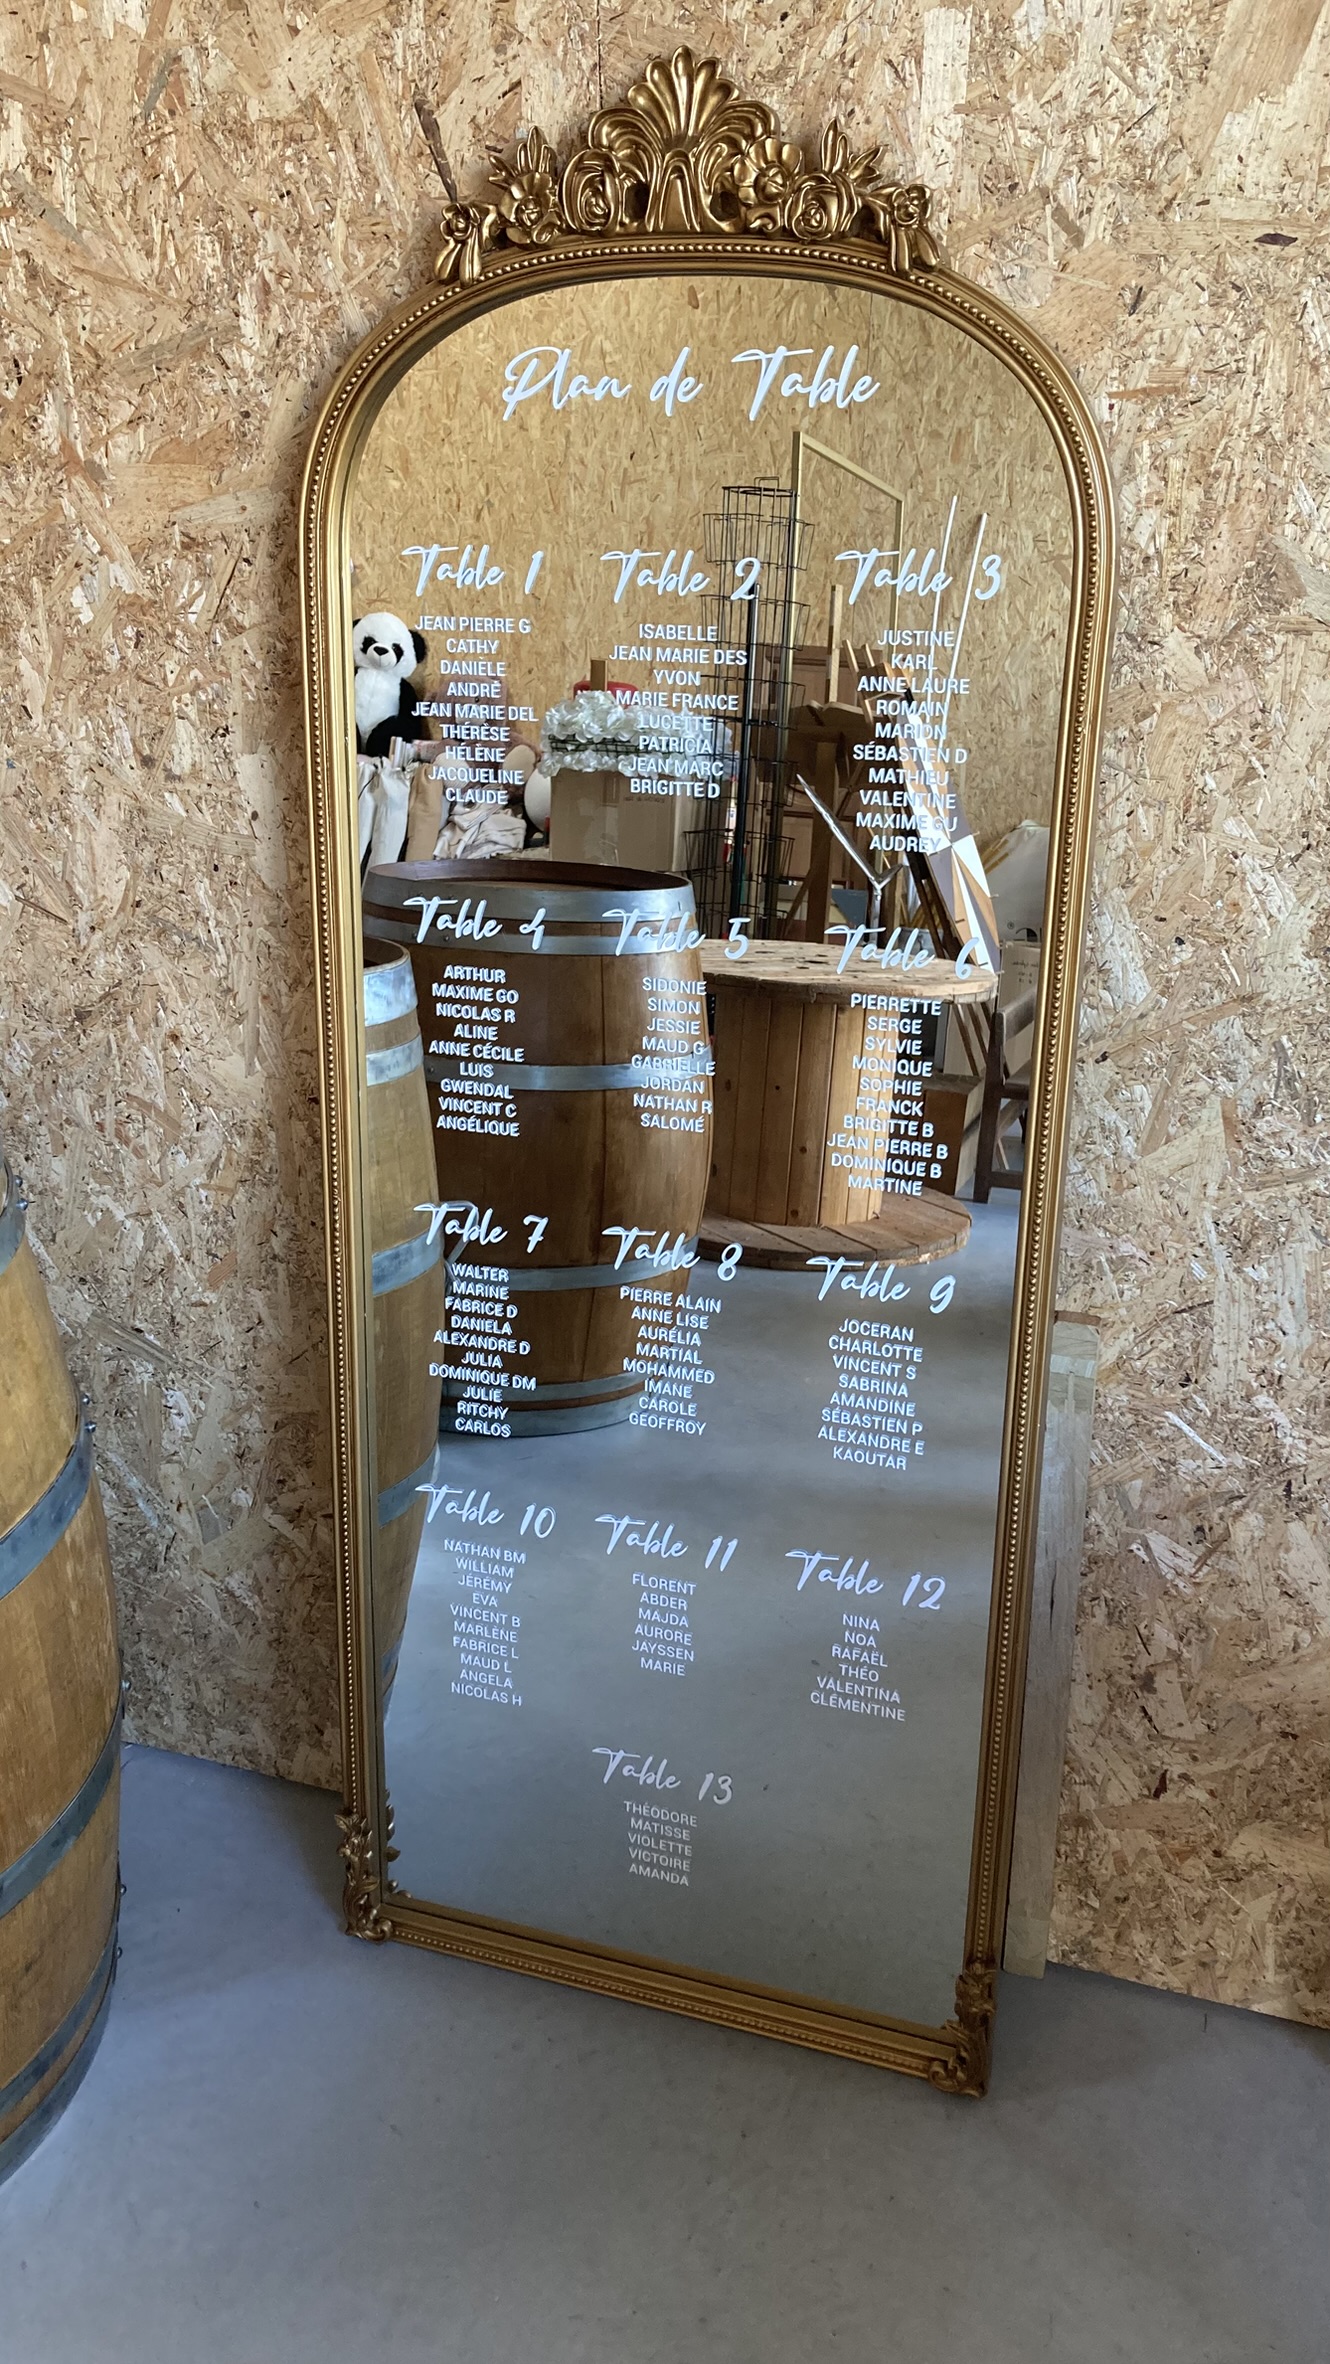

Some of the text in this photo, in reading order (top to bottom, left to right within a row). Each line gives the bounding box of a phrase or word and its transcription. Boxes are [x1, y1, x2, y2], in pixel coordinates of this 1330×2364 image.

[502, 344, 880, 421] Plan de Table
[401, 544, 544, 597] Table 1
[600, 549, 761, 603] Table 2
[834, 548, 1001, 605] Table 3
[415, 616, 531, 633] JEAN PIERRE G
[639, 624, 718, 641] ISABELLE
[446, 639, 499, 654] CATHY
[877, 630, 955, 647] JUSTINE
[609, 646, 748, 665] JEAN MARIE DES
[891, 654, 938, 670] KARL
[440, 657, 506, 676] DANIÈLE
[653, 670, 701, 686] YVON
[857, 675, 970, 695] ANNE LAURE
[447, 680, 501, 698] ANDRÉ
[616, 690, 739, 711] MARIE FRANCE
[876, 700, 949, 717] ROMAIN
[411, 702, 539, 721] JEAN MARIE DEL
[439, 723, 510, 742] THÉRÈSE
[445, 744, 506, 763] HÉLÈNE
[853, 742, 968, 764] SÉBASTIEN D
[428, 766, 525, 785] JACQUELINE
[446, 788, 508, 805] CLAUDE
[630, 779, 720, 799] BRIGITTE D
[859, 790, 956, 809] VALENTINE
[403, 896, 546, 950] Table 4
[602, 909, 751, 960] Table 5
[824, 924, 979, 980] Table 6
[443, 965, 506, 983] ARTHUR
[432, 983, 519, 1004] MAXIME GO
[642, 977, 707, 995] SIDONIE
[436, 1003, 516, 1023] NICOLAS R
[648, 998, 701, 1014] SIMON
[850, 993, 941, 1015] PIERRETTE
[454, 1024, 498, 1040] ALINE
[647, 1018, 701, 1035] JESSIE
[867, 1016, 922, 1035] SERGE
[429, 1040, 525, 1063] ANNE CÉCILE
[642, 1036, 704, 1055] MAUD G
[865, 1037, 922, 1055] SYLVIE
[459, 1062, 494, 1078] LUIS
[852, 1055, 933, 1077] MONIQUE
[441, 1079, 514, 1099] GWENDAL
[439, 1097, 517, 1118] VINCENT C
[633, 1093, 712, 1114] NATHAN R
[856, 1097, 923, 1117] FRANCK
[436, 1115, 520, 1137] ANGÉLIQUE
[640, 1113, 705, 1133] SALOMÉ
[843, 1115, 934, 1138] BRIGITTE B
[827, 1134, 948, 1159] JEAN PIERRE B
[832, 1153, 942, 1179] DOMINIQUE B
[848, 1175, 923, 1196] MARTINE
[413, 1202, 550, 1253] Table 7
[602, 1226, 743, 1282] Table 8
[452, 1263, 510, 1282] WALTER
[452, 1281, 510, 1300] MARINE
[806, 1256, 956, 1314] Table 9
[445, 1296, 518, 1318] FABRICE D
[620, 1286, 722, 1314] PIERRE ALAIN
[451, 1315, 512, 1335] DANIELA
[631, 1306, 710, 1330] ANNE LISE
[638, 1325, 702, 1346] AURÉLIA
[839, 1319, 914, 1342] JOCERAN
[433, 1330, 530, 1355] ALEXANDRE D
[829, 1335, 923, 1363] CHARLOTTE
[461, 1351, 503, 1368] JULIA
[636, 1342, 703, 1365] MARTIAL
[429, 1363, 537, 1391] DOMINIQUE DM
[623, 1357, 715, 1384] MOHAMMED
[832, 1354, 917, 1380] VINCENT S
[463, 1385, 503, 1402] JULIE
[645, 1378, 694, 1398] IMANE
[839, 1374, 909, 1398] SABRINA
[457, 1401, 510, 1421] RITCHY
[639, 1397, 697, 1417] CAROLE
[830, 1392, 916, 1417] AMANDINE
[455, 1417, 512, 1438] CARLOS
[629, 1413, 707, 1436] GEOFFROY
[821, 1407, 923, 1435] SÉBASTIEN P
[818, 1425, 925, 1455] ALEXANDRE E
[833, 1446, 907, 1470] KAOUTAR
[415, 1483, 556, 1538] Table 10
[595, 1514, 739, 1572] Table 11
[456, 1556, 514, 1579] WILLIAM
[458, 1573, 512, 1594] JÉRÉMY
[632, 1572, 697, 1595] FLORENT
[785, 1549, 946, 1610] Table 12
[472, 1592, 498, 1607] EVA
[640, 1592, 688, 1611] ABDER
[450, 1604, 521, 1627] VINCENT B
[638, 1608, 689, 1628] MAJDA
[843, 1613, 880, 1631] NINA
[635, 1623, 692, 1646] AURORE
[845, 1630, 876, 1648] NOA
[453, 1636, 519, 1659] FABRICE L
[632, 1640, 695, 1662] JAYSSEN
[460, 1653, 512, 1673] MAUD L
[641, 1657, 686, 1676] MARIE
[839, 1664, 879, 1682] THÉO
[452, 1682, 522, 1706] NICOLAS H
[816, 1675, 901, 1704] VALENTINA
[592, 1747, 733, 1805] Table 13
[624, 1801, 698, 1827] THÉODORE
[629, 1863, 689, 1886] AMANDA
